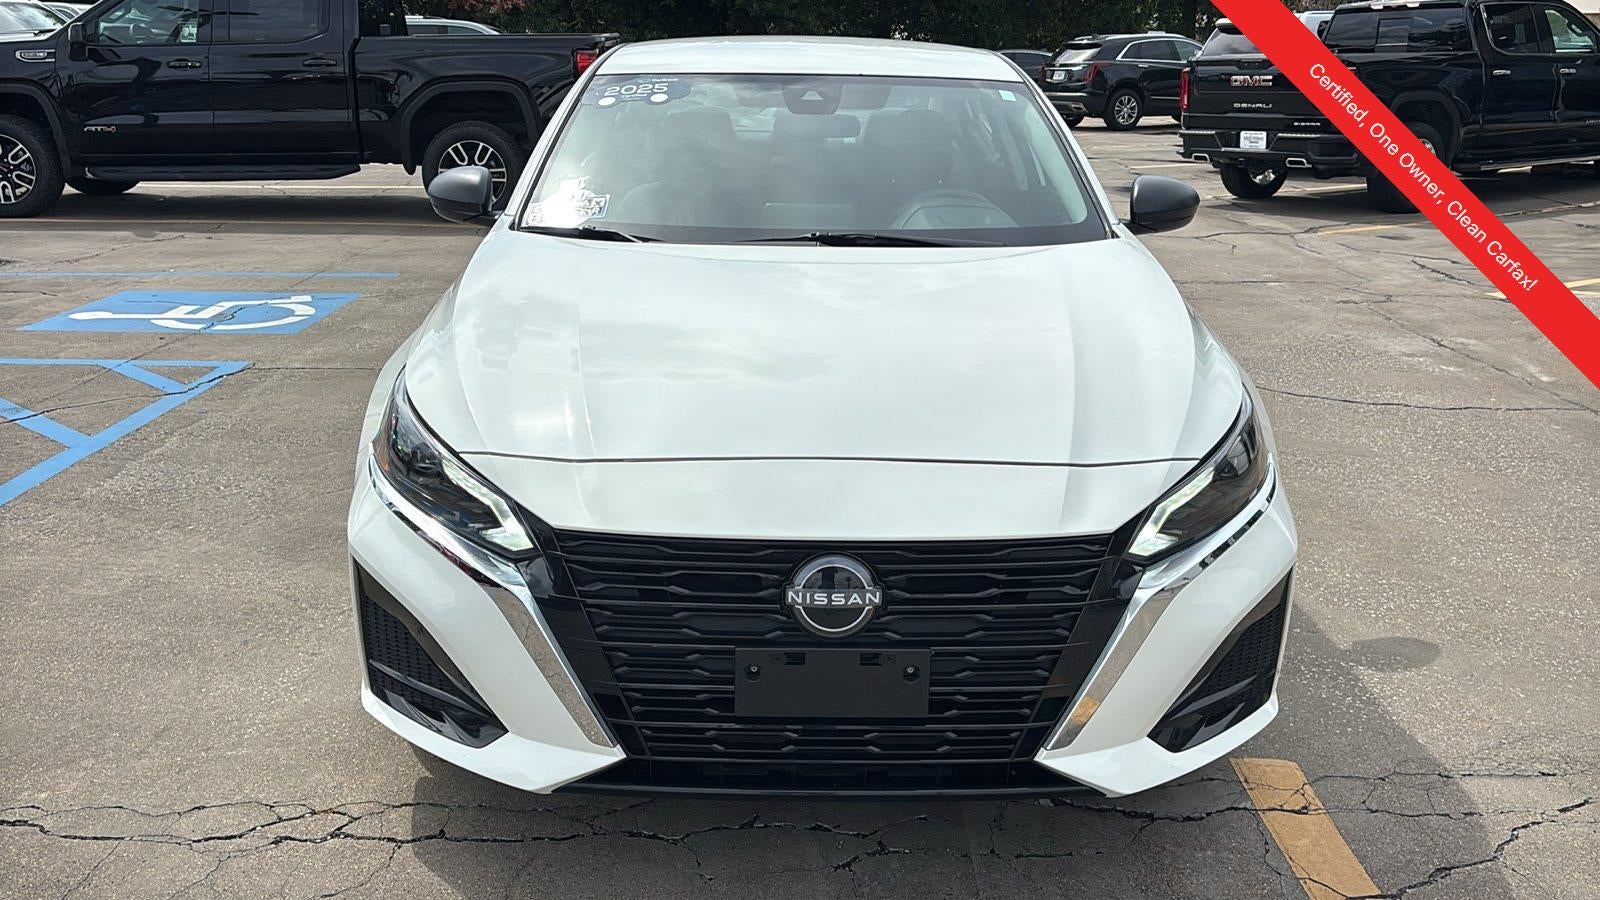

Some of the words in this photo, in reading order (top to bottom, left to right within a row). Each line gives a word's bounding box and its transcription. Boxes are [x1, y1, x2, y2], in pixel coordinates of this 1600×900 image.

[1231, 76, 1273, 86] GMC
[604, 83, 668, 96] 2025
[788, 591, 880, 605] NISSAN
